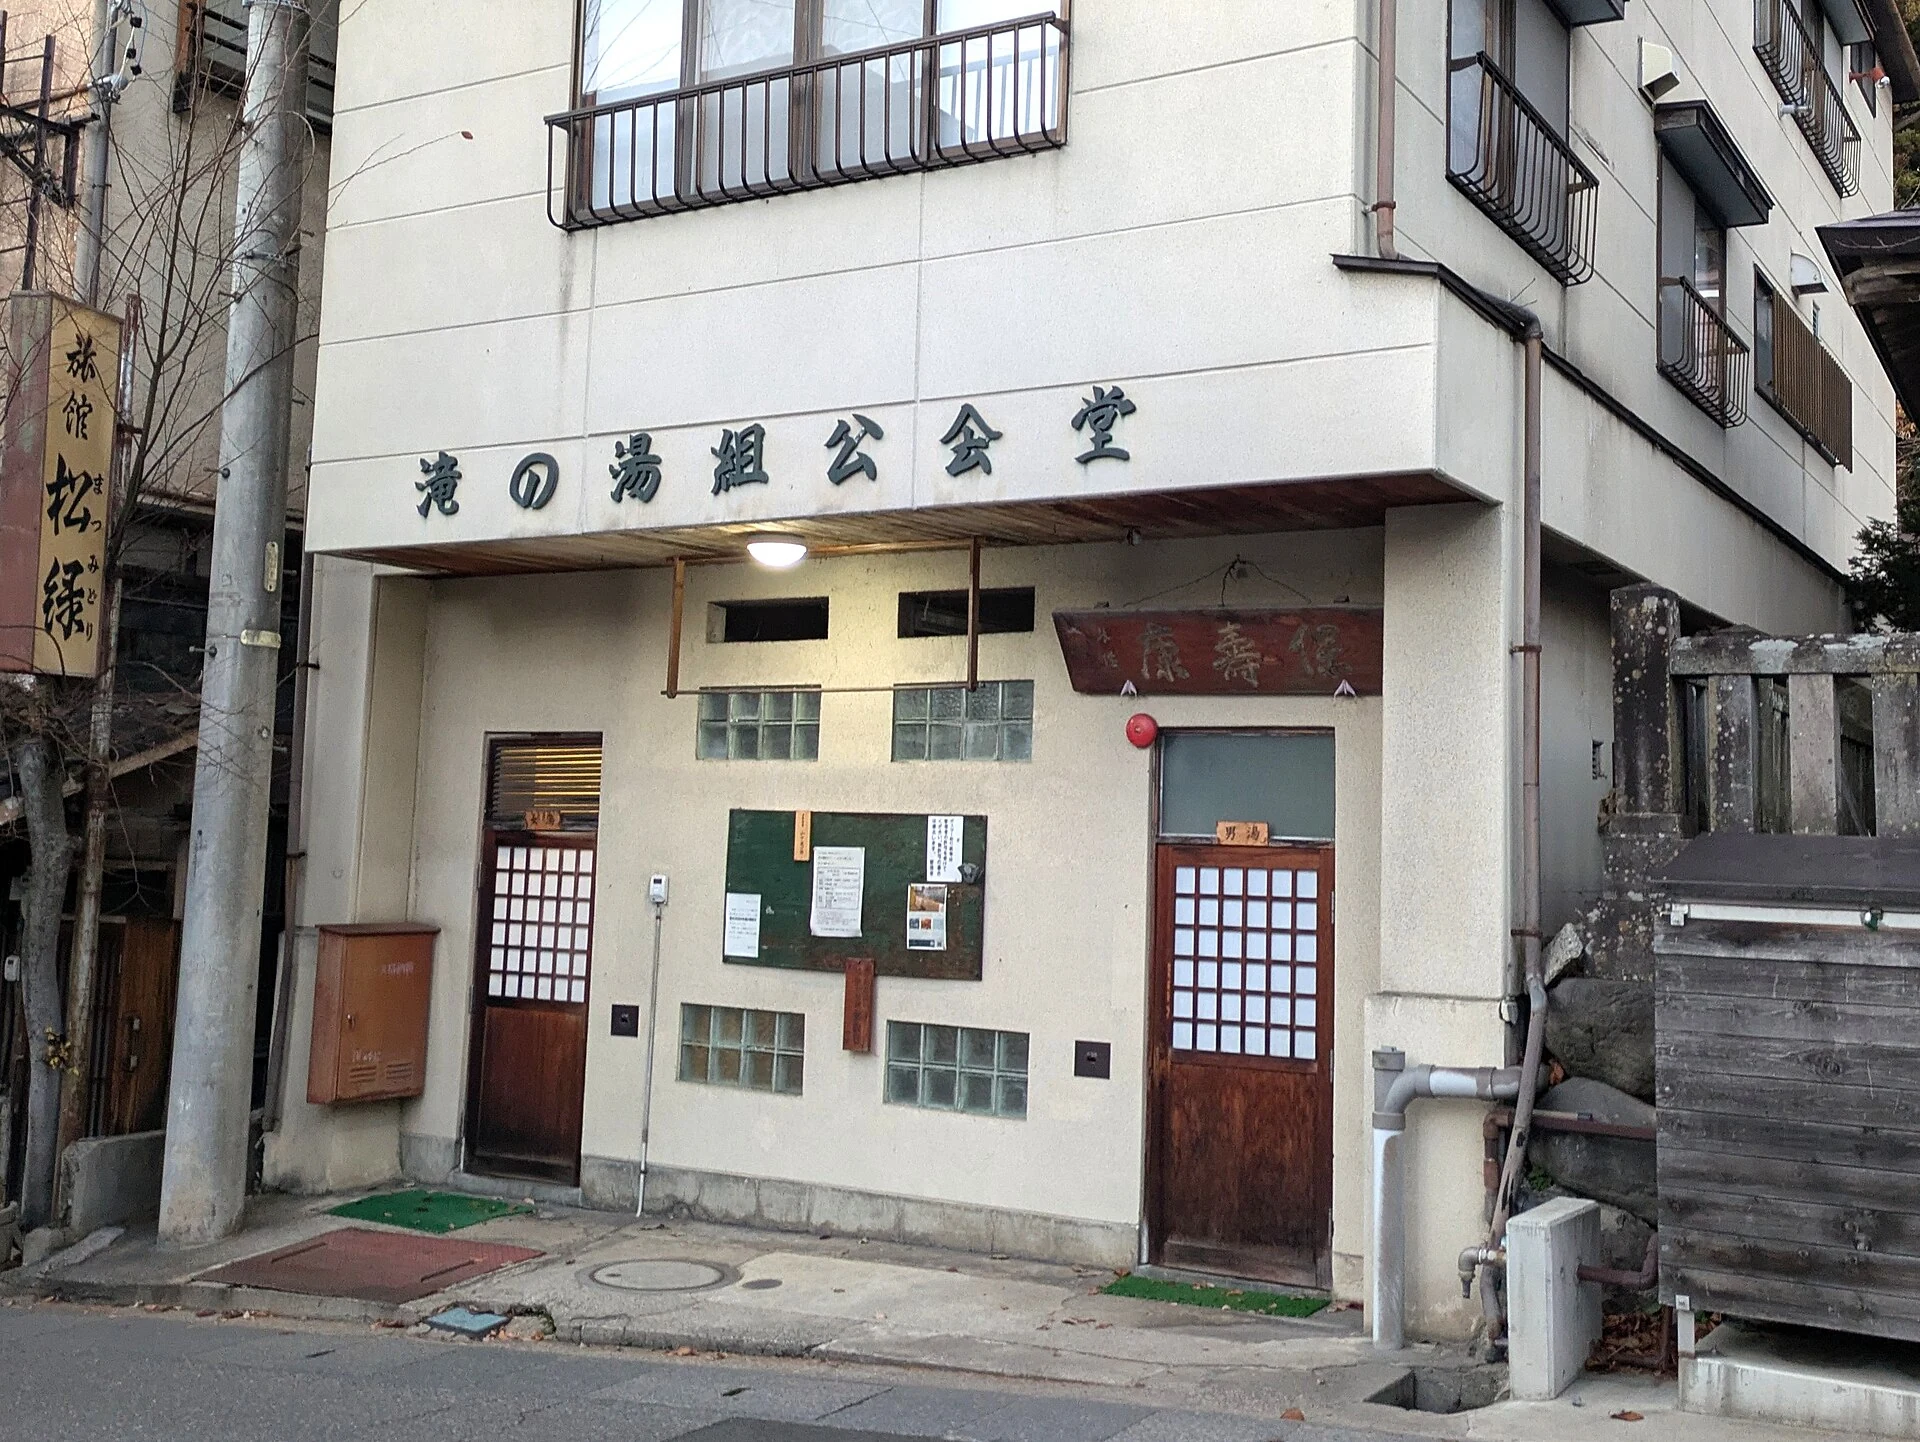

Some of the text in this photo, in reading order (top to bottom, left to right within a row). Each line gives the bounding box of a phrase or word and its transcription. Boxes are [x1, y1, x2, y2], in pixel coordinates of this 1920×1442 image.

[414, 384, 1137, 518] 滝の湯組公会堂
[1225, 824, 1261, 841] 男湯
